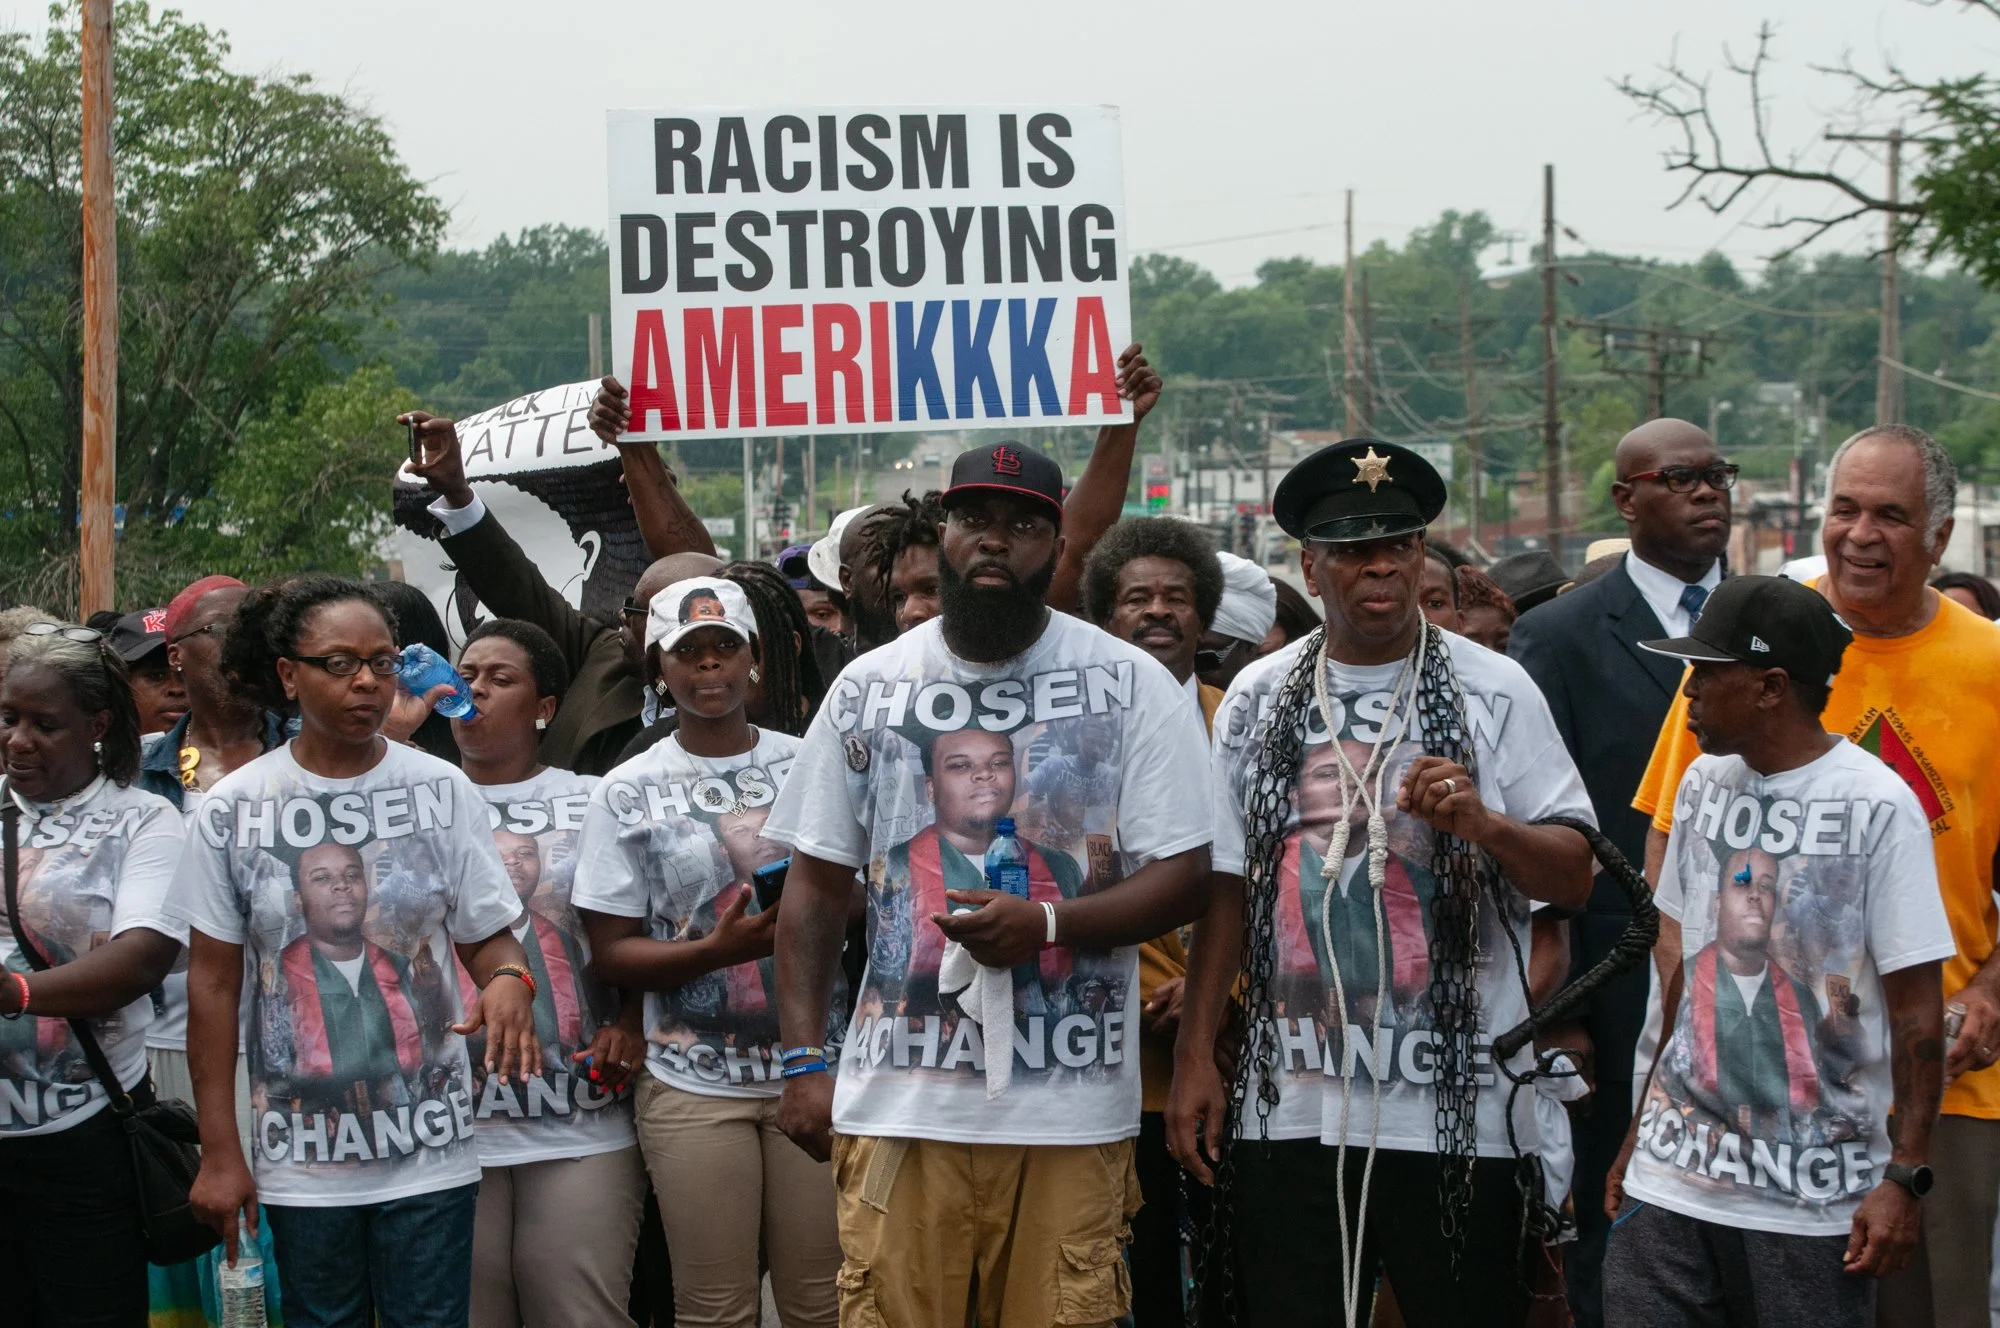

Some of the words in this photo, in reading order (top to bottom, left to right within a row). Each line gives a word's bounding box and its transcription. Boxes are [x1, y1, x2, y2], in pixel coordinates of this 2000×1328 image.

[654, 113, 970, 195] RACISM
[998, 112, 1076, 189] IS
[620, 203, 1118, 294] DESTROYING
[627, 295, 1124, 433] AMERIKKKA
[458, 406, 607, 468] ATTE
[829, 660, 1134, 733] CHOSEN
[200, 777, 453, 848] CHOSEN
[1673, 768, 1897, 857] CHOSEN
